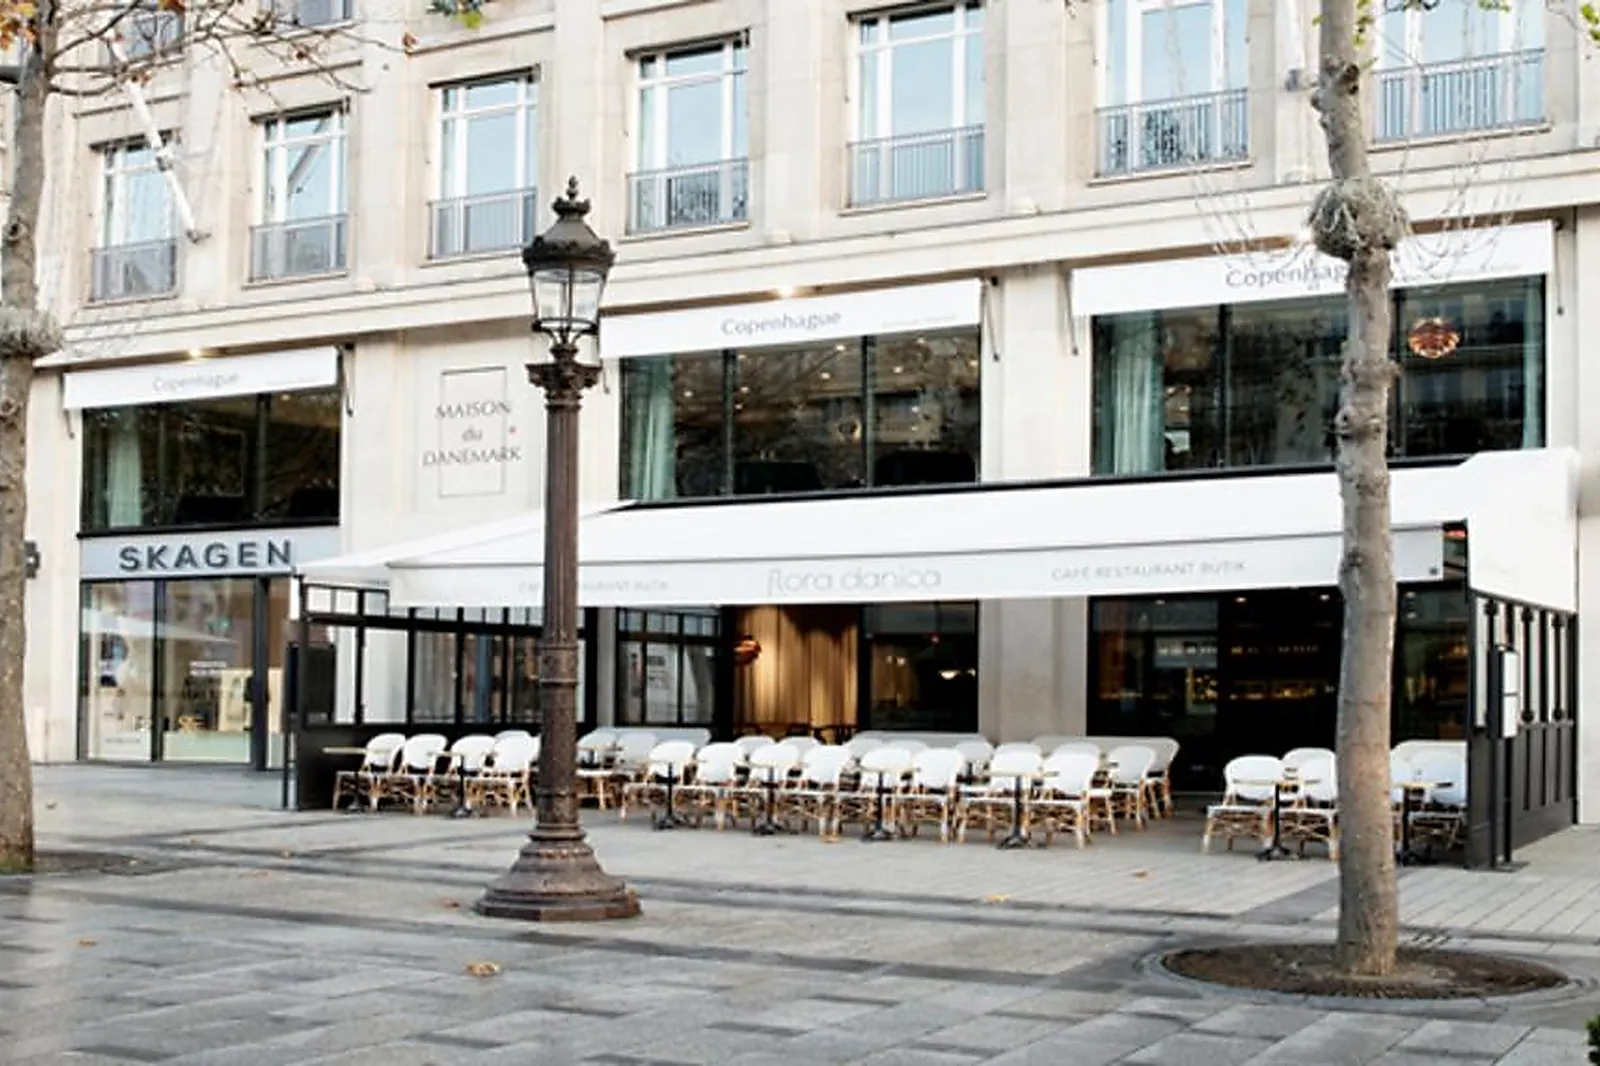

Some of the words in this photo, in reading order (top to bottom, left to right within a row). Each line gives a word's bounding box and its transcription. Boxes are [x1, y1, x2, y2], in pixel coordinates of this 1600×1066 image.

[721, 312, 841, 336] Copenhague
[435, 400, 511, 418] MAISON
[461, 425, 482, 442] du
[423, 447, 521, 467] DANEMARK
[119, 540, 293, 571] SKAGEN
[1094, 561, 1195, 578] RESTAURANT
[767, 567, 834, 597] flora
[839, 564, 942, 591] danica
